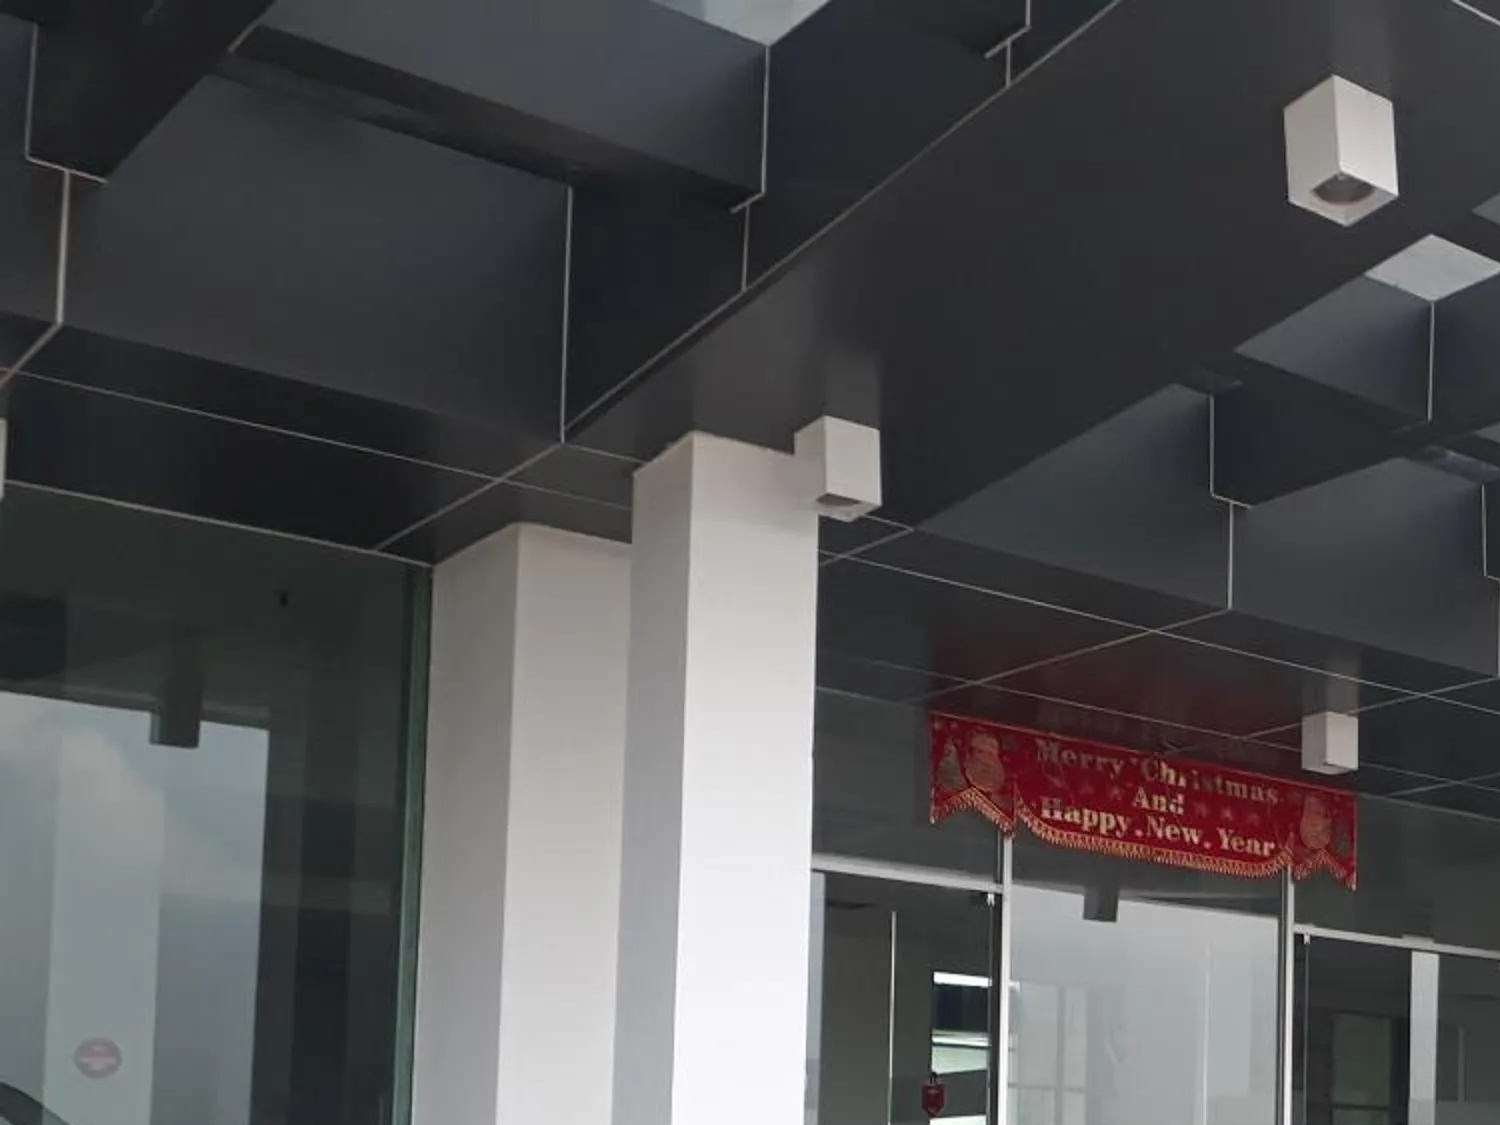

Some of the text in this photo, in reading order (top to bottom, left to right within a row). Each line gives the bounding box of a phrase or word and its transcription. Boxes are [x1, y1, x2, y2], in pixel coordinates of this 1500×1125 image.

[1035, 738, 1279, 803] Merry Christmas
[1131, 786, 1185, 815] And
[1040, 797, 1276, 857] Happy New Year
